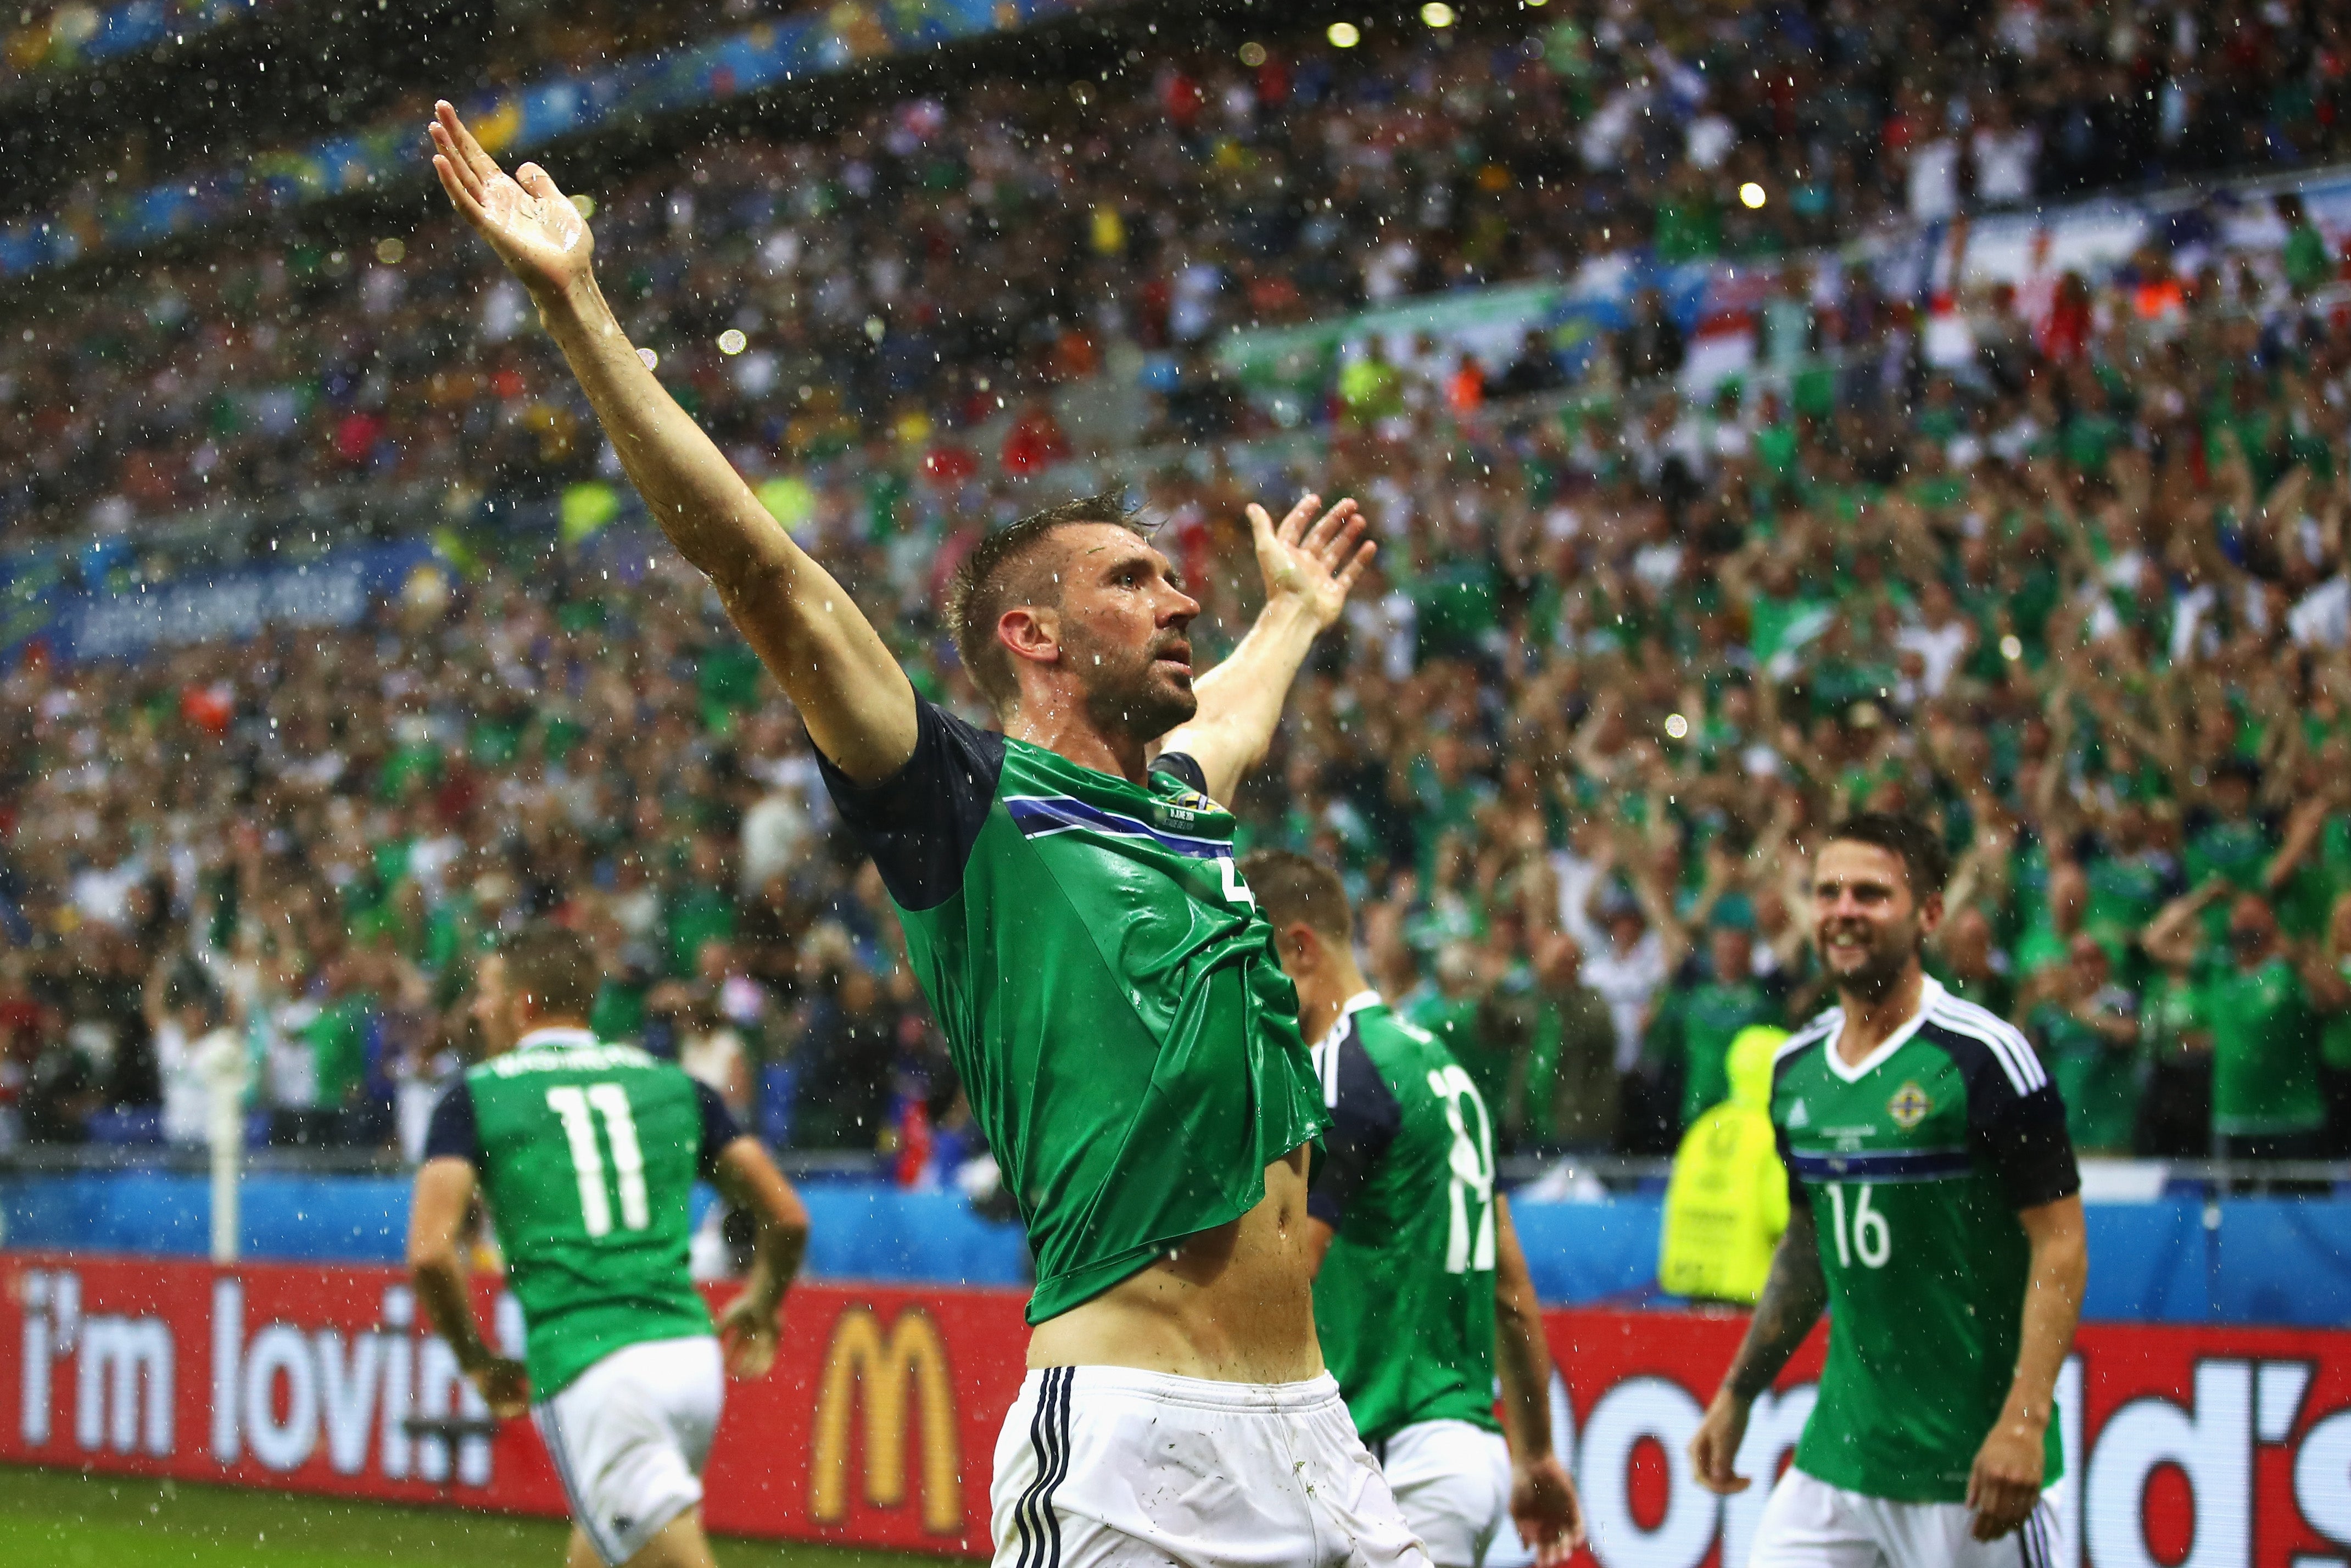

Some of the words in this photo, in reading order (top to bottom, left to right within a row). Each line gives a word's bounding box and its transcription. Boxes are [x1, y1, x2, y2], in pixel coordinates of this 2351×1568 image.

[546, 1082, 650, 1237] 11
[1824, 1181, 1892, 1269] 16
[20, 1266, 176, 1459] i'm
